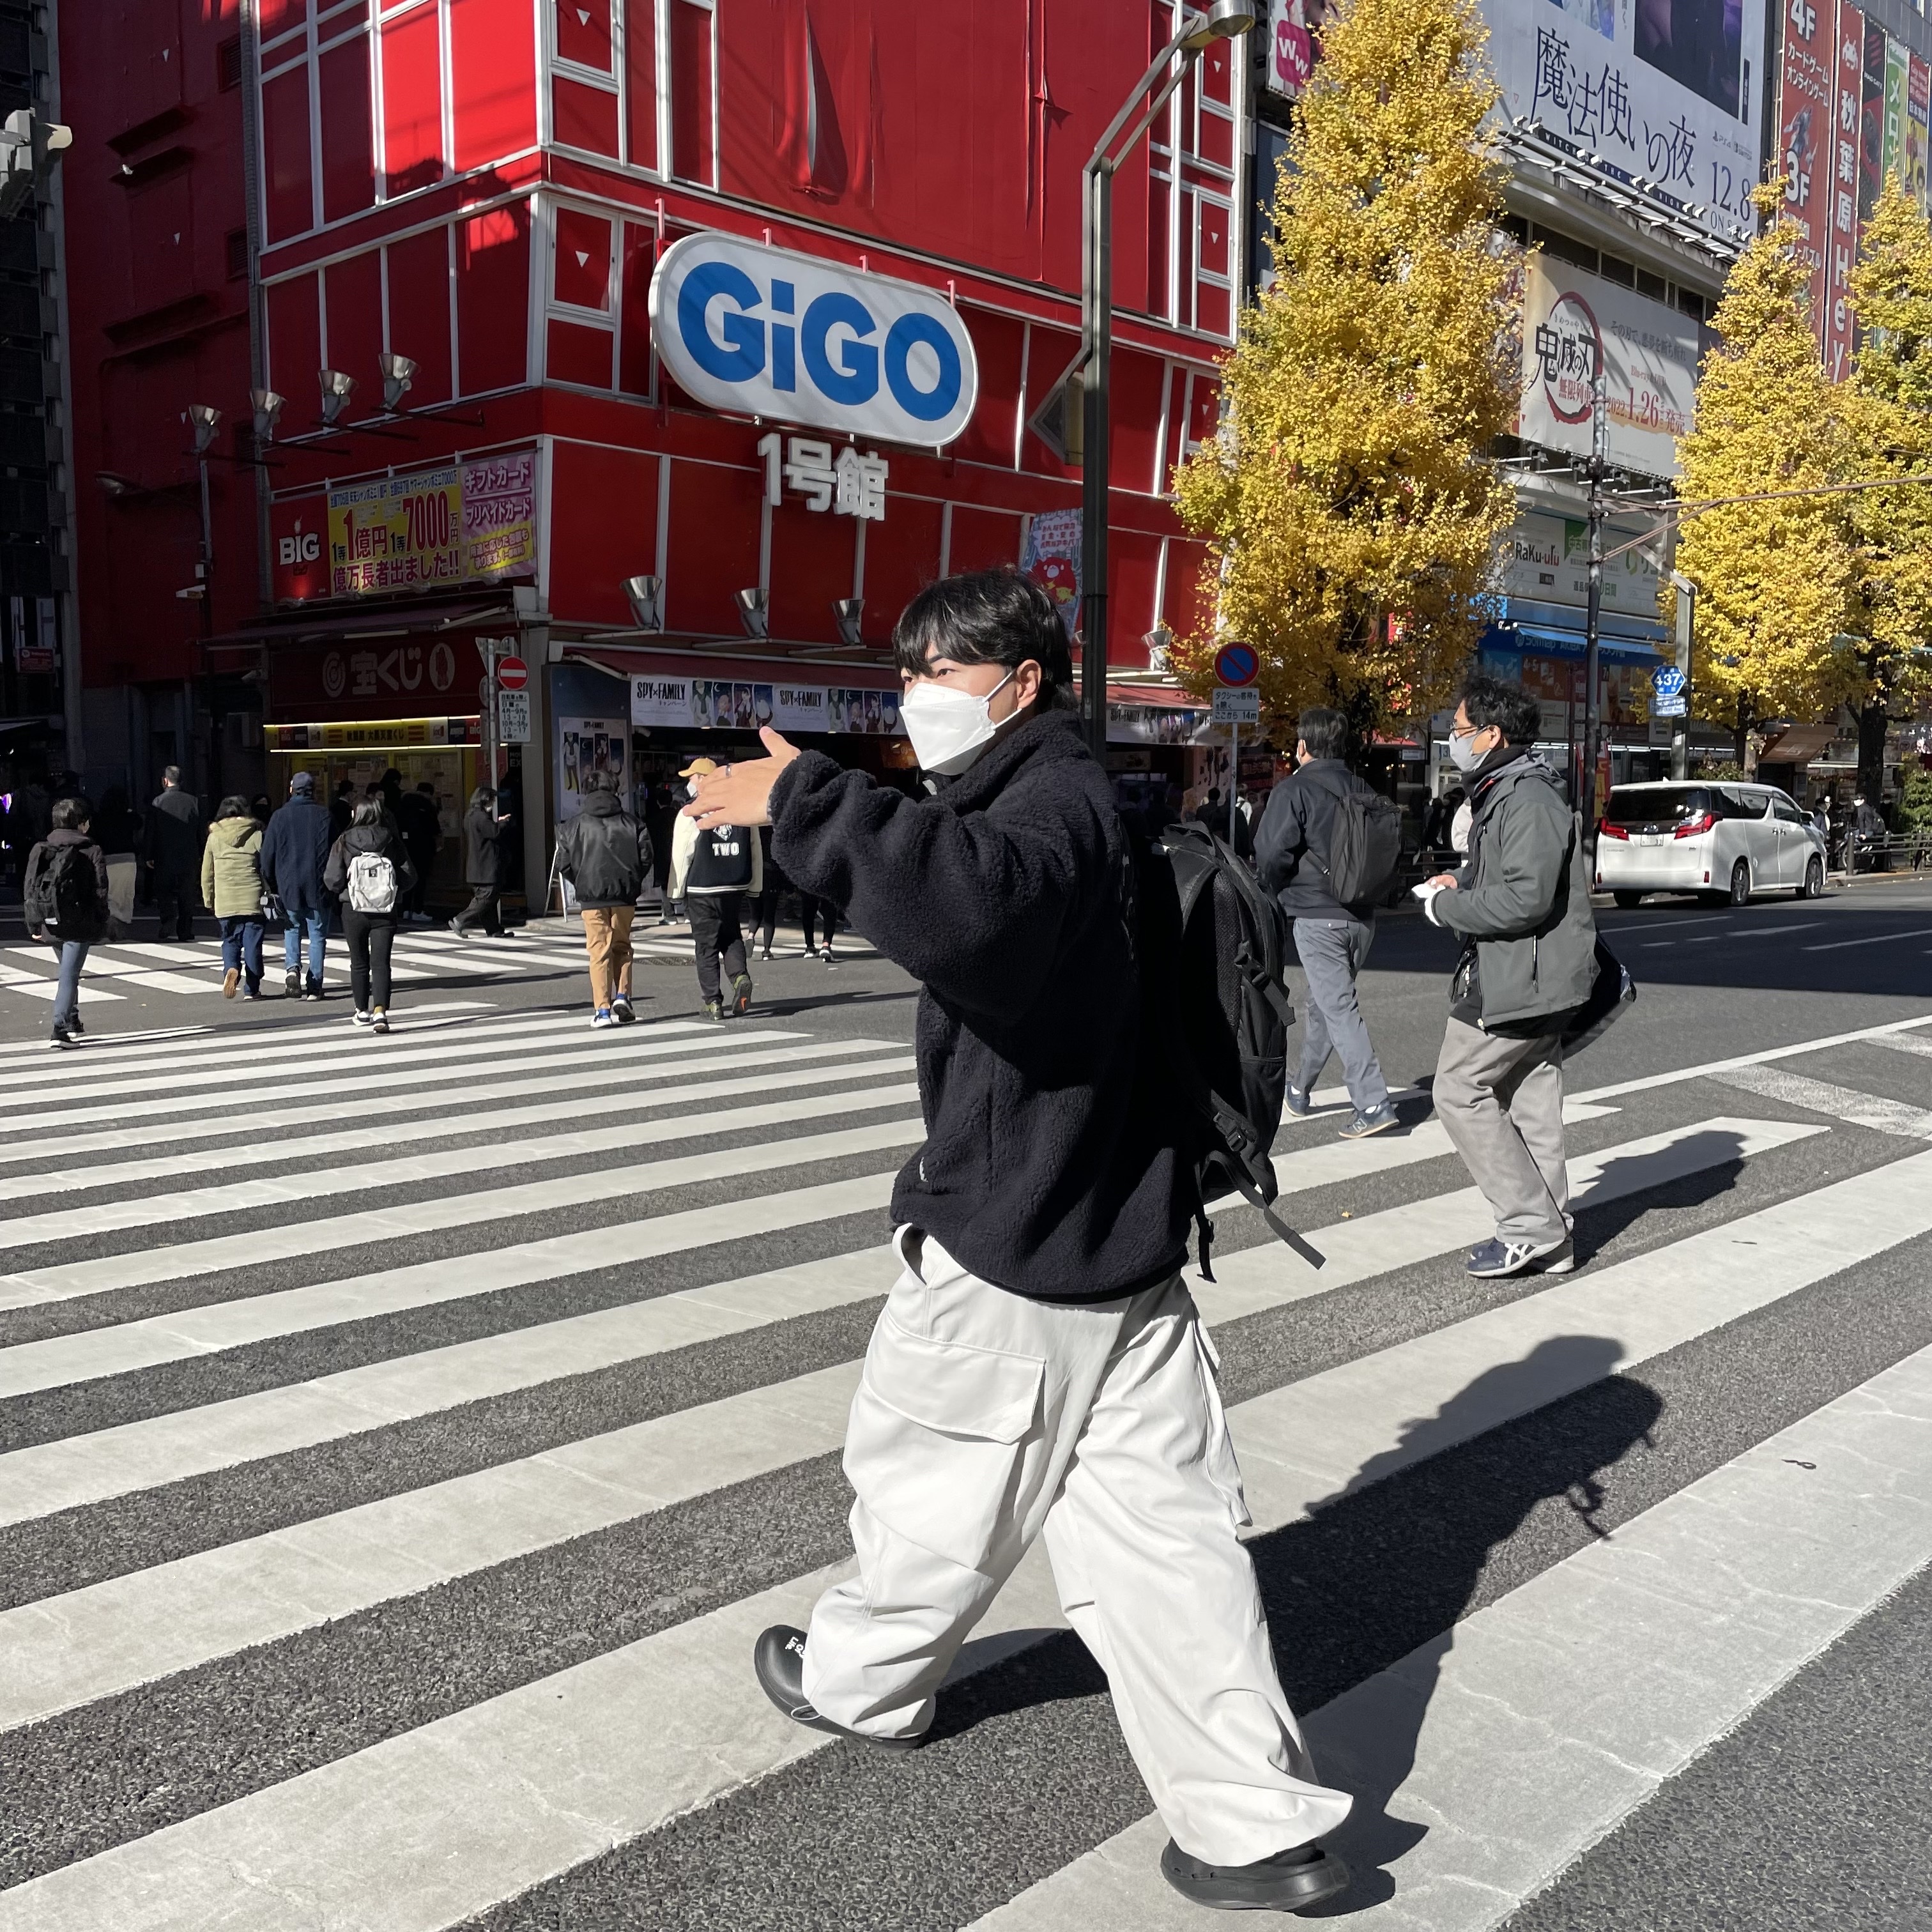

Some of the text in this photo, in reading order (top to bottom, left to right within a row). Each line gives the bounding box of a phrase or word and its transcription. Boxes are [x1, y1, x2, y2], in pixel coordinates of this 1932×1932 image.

[1791, 0, 1816, 40] 4F
[1788, 41, 1829, 84] カードゲーム
[1529, 26, 1697, 188] 魔法使いの夜
[1786, 65, 1828, 108] オンラインゲーム
[1712, 161, 1751, 222] 12.8
[1785, 150, 1810, 208] 3F
[1710, 211, 1725, 234] ON
[677, 261, 962, 422] GiGO
[1528, 322, 1597, 389] 鬼滅の刃
[464, 461, 530, 493] ギフトカード
[758, 433, 889, 521] 1号館
[466, 497, 531, 528] プリペイドカード
[278, 532, 321, 566] BIG
[333, 549, 459, 594] 億万長者出ました!!
[350, 646, 423, 696] 宝くじ
[1654, 673, 1681, 686] 437
[1215, 711, 1257, 720] ここから 14m
[712, 841, 740, 857] TWO
